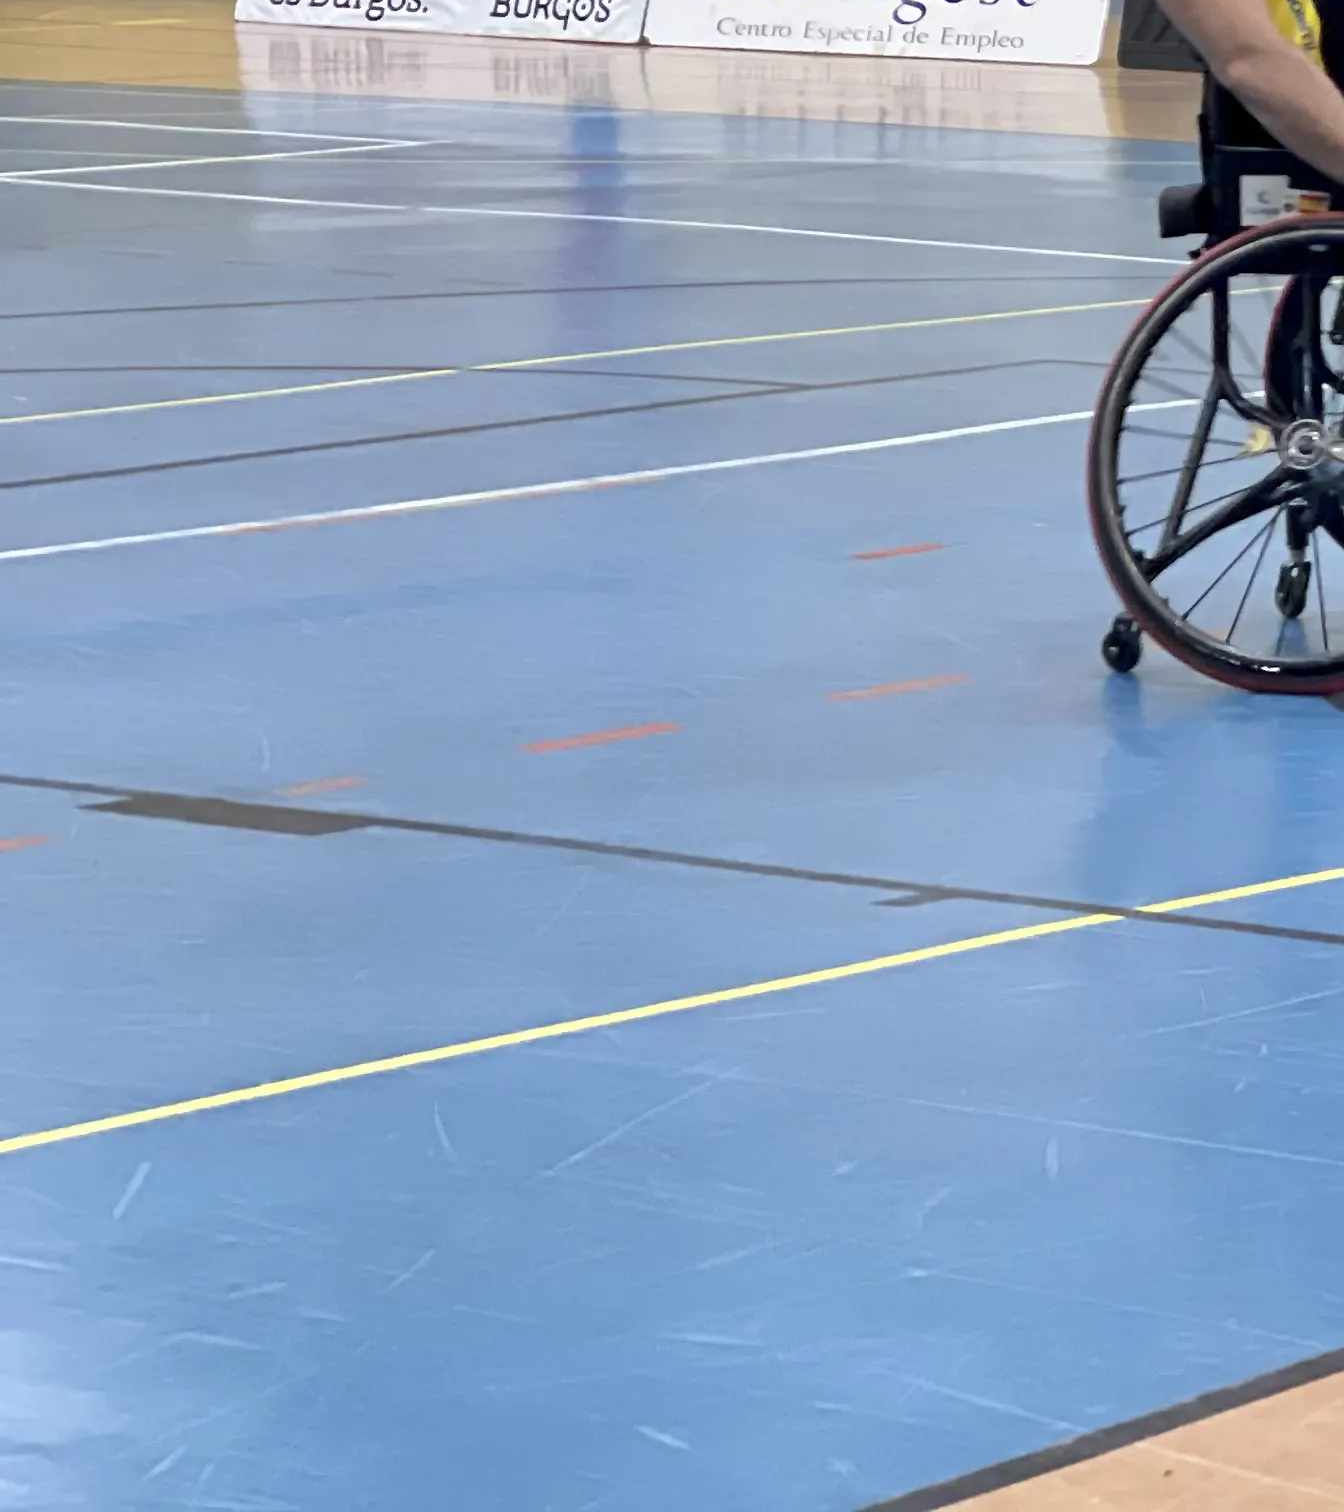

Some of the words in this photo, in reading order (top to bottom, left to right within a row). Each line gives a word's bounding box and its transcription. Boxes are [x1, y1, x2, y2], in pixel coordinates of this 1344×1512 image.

[716, 16, 792, 39] Centro
[803, 20, 893, 47] Especial
[902, 23, 929, 45] de
[941, 26, 1025, 54] Empleo
